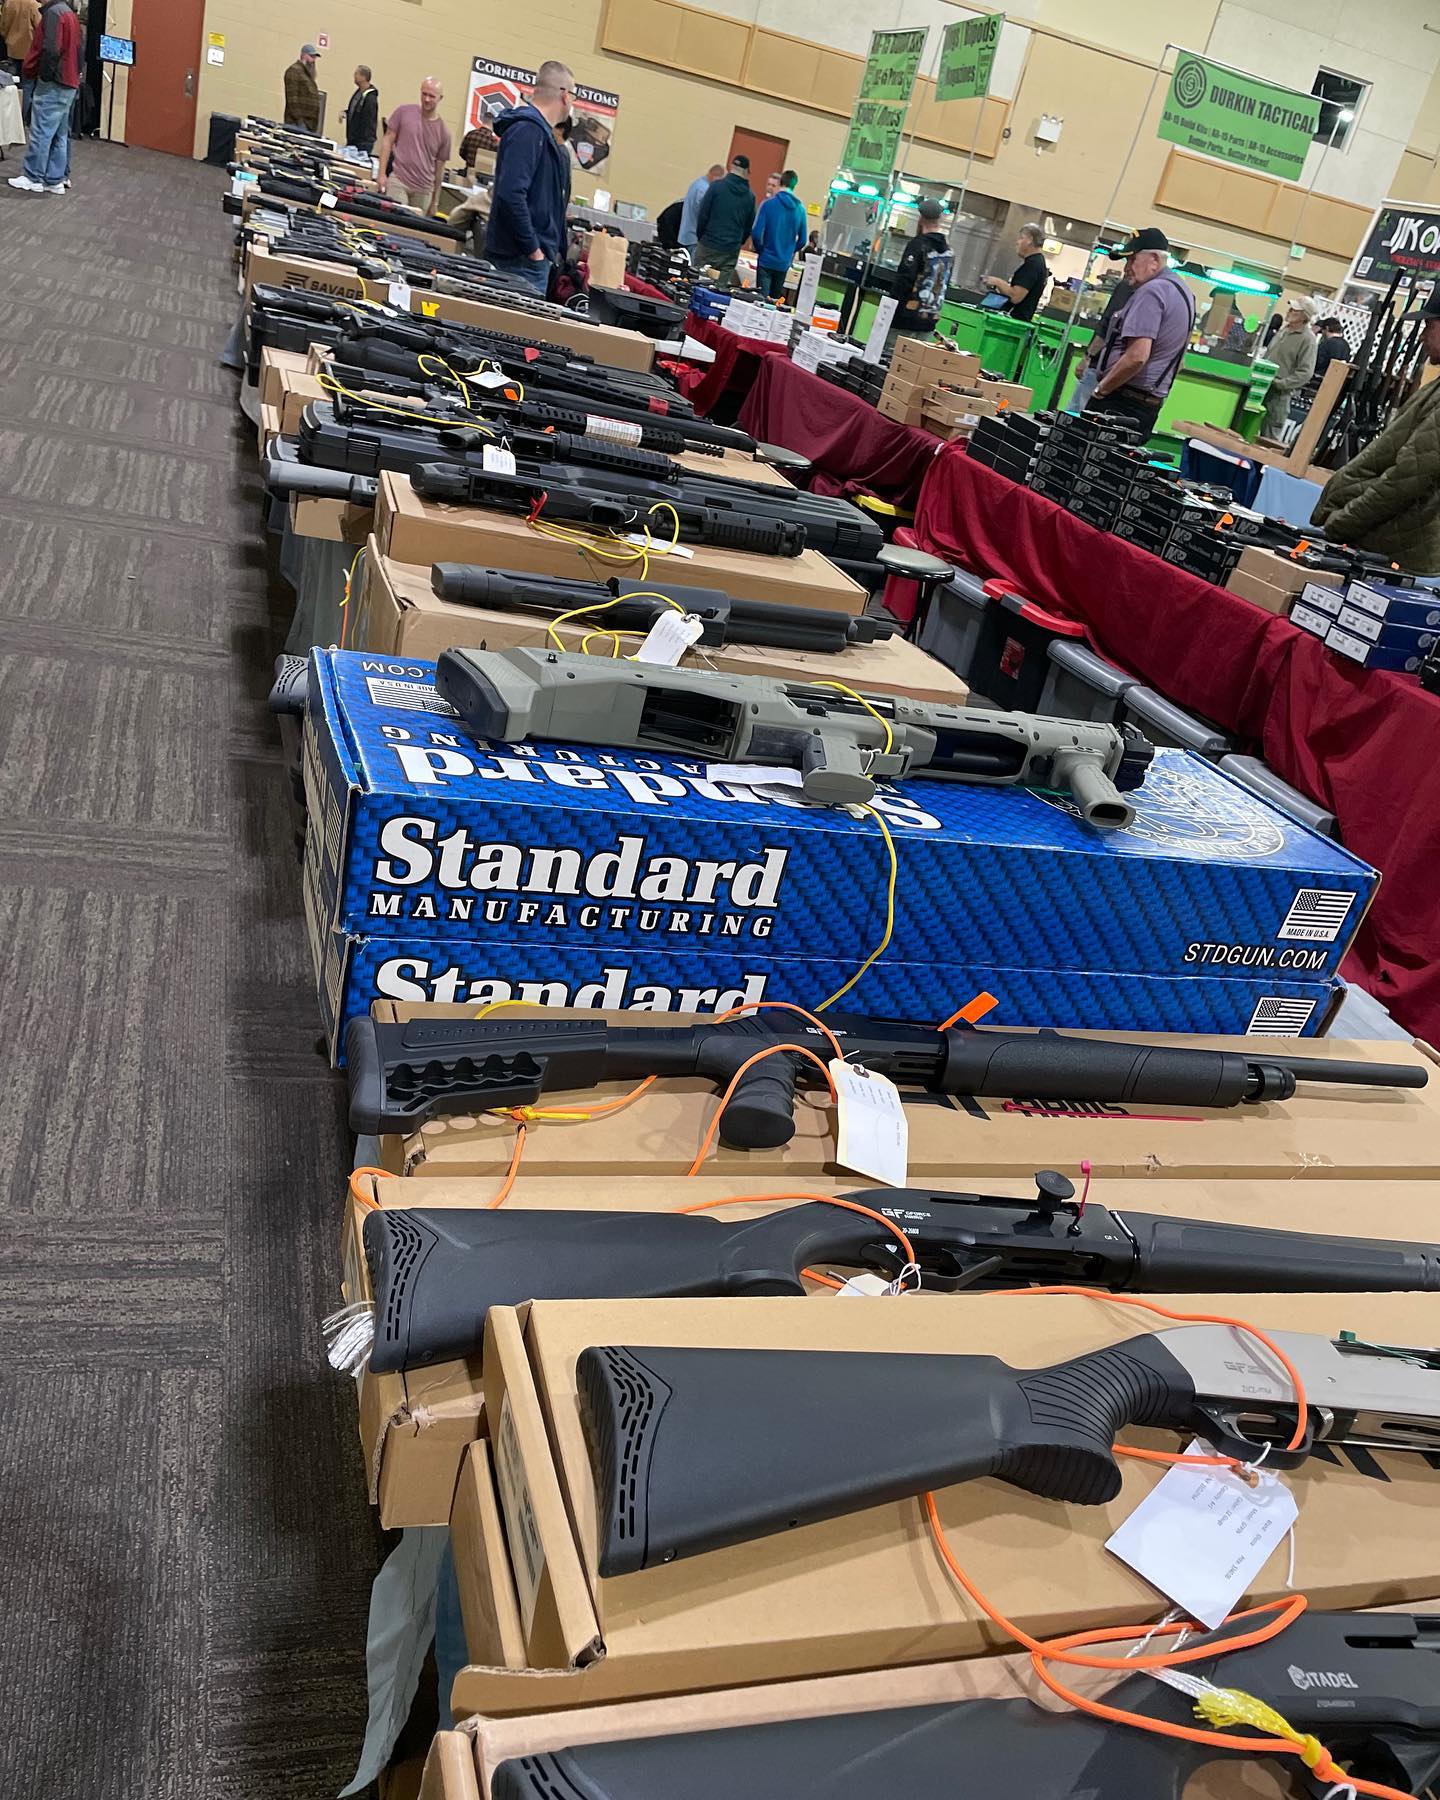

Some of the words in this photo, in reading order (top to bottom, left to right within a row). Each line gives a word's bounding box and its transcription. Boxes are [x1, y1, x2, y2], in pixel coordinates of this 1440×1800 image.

[475, 59, 536, 85] CORNERST
[574, 86, 618, 107] USTOMS
[1210, 85, 1257, 116] DURKIN
[1257, 101, 1316, 134] TACTICAL
[1381, 217, 1440, 254] JJKO
[310, 281, 363, 300] SAVAGE
[387, 743, 943, 829] Sndard
[376, 816, 789, 908] Standard
[370, 893, 773, 937] MANUFACTURING
[1286, 928, 1305, 936] MADE
[1305, 929, 1313, 937] IN
[1184, 943, 1328, 970] STDGUN.COM
[376, 958, 767, 1015] Standard
[881, 1208, 904, 1219] GF
